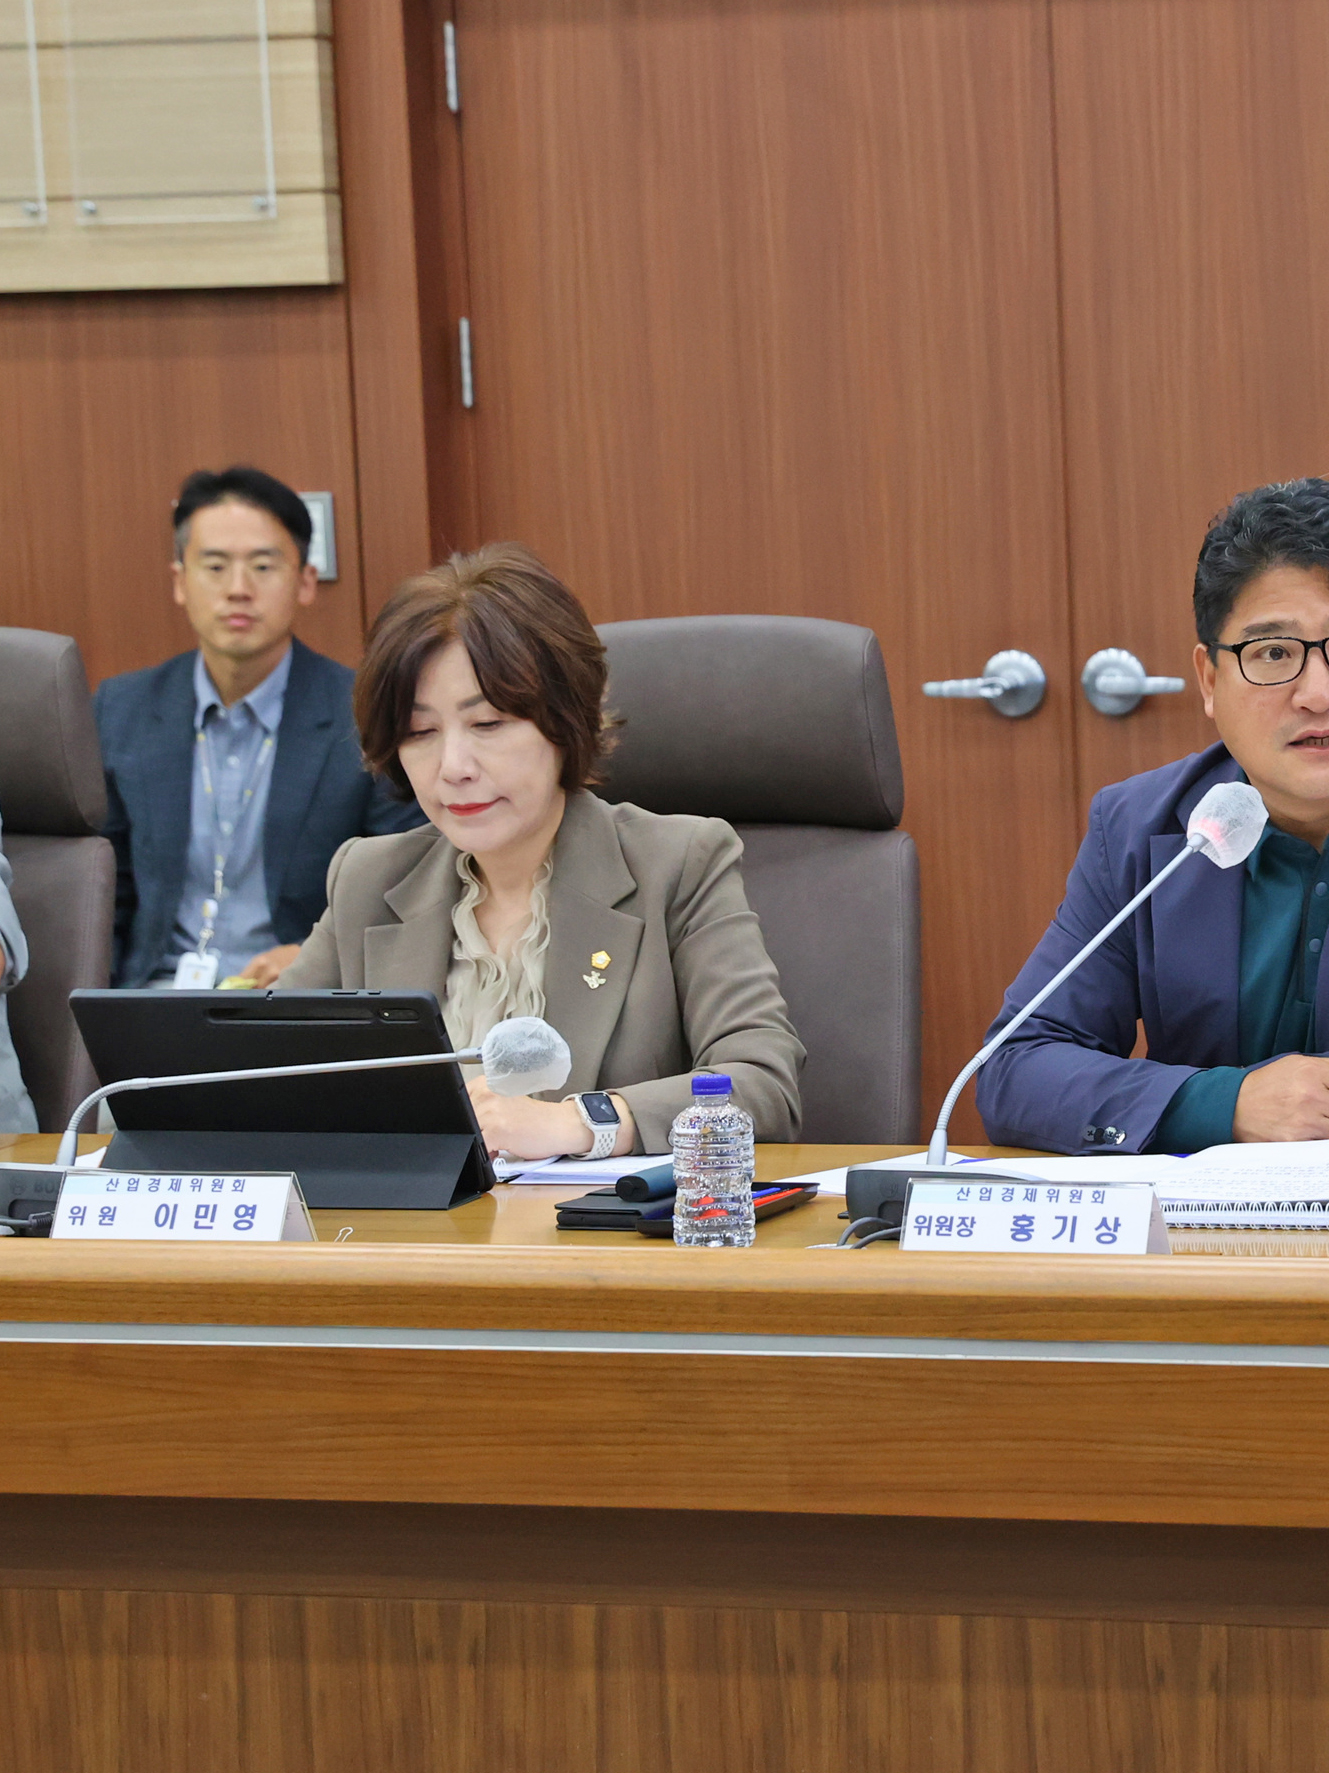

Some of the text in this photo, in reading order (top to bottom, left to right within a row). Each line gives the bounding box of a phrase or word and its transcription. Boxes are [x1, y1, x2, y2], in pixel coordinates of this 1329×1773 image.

[105, 1177, 247, 1193] 산업경제위원회
[956, 1186, 1107, 1205] 산업경제위원회
[68, 1203, 258, 1231] 위원 이민영
[913, 1213, 1123, 1245] 위원장 홍기상
